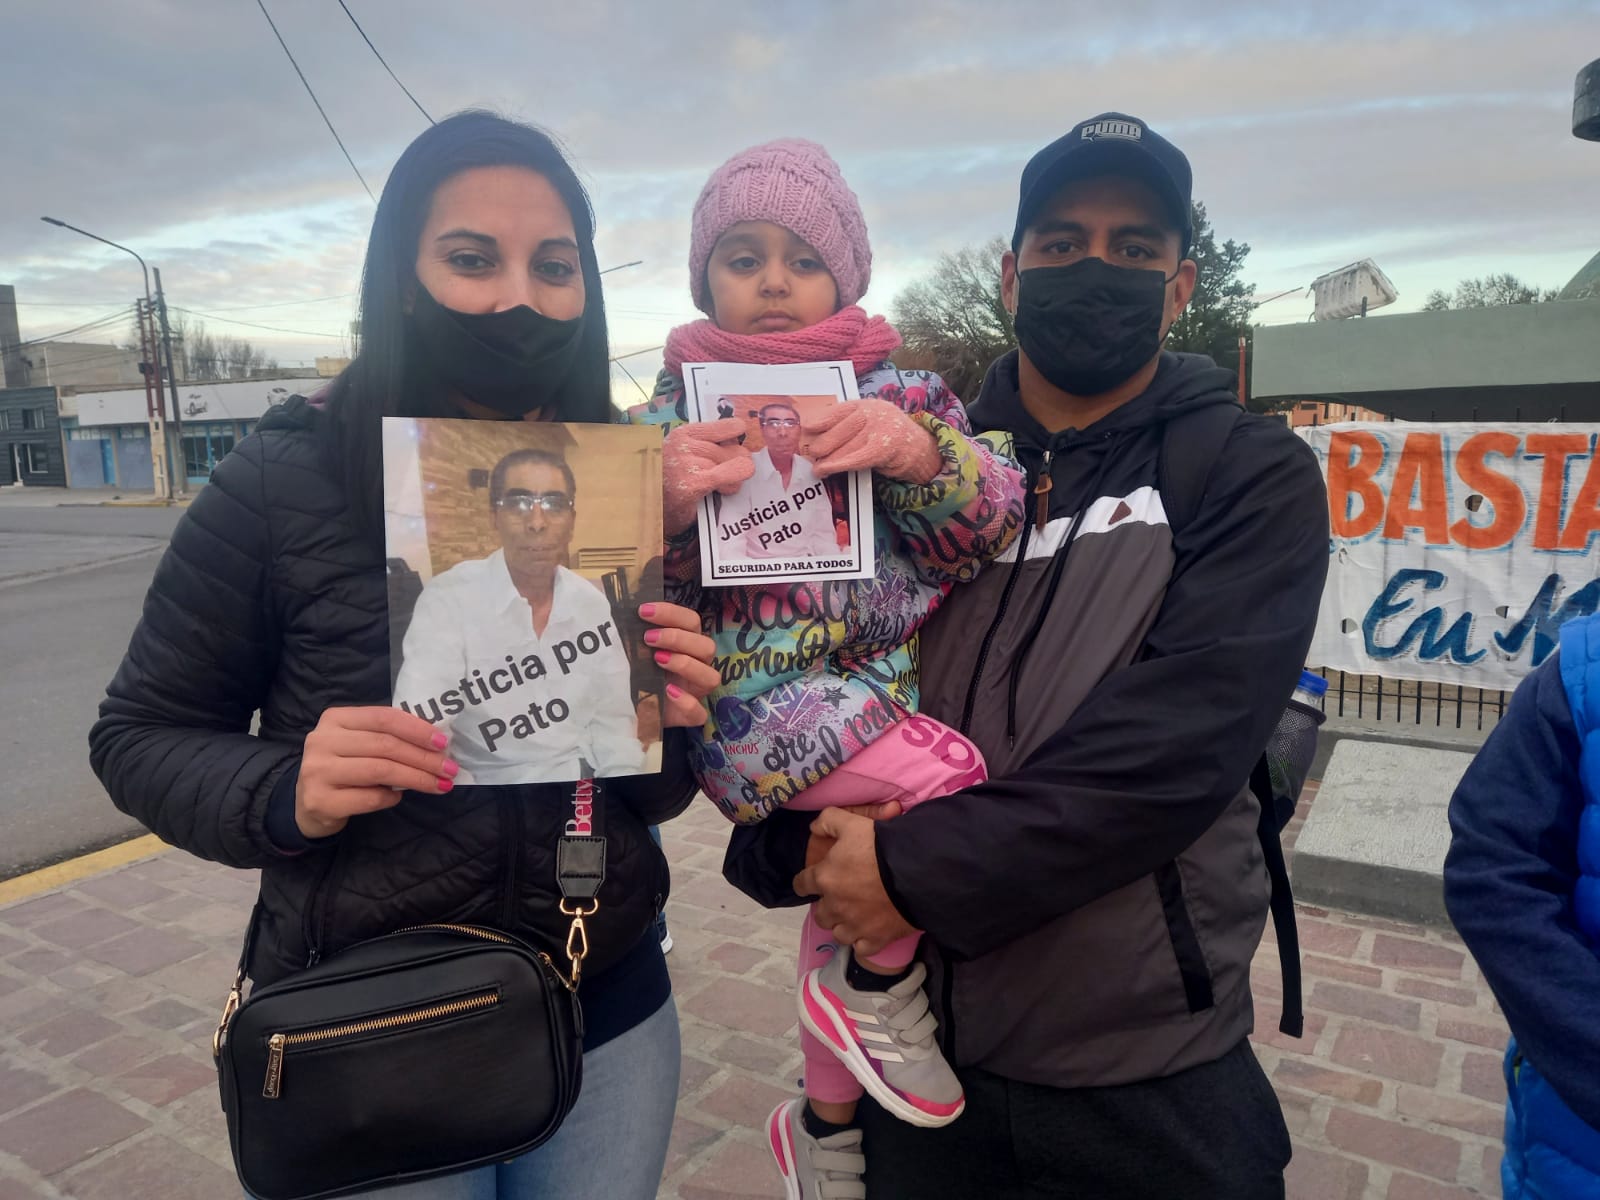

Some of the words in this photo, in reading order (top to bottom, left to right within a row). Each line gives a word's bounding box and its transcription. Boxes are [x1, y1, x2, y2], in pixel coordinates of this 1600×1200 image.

[1081, 122, 1142, 141] PUMA
[719, 499, 791, 541] Justicia
[792, 481, 823, 511] por
[1326, 431, 1600, 551] BASTA
[757, 521, 803, 550] Pato
[718, 562, 782, 574] SEGURIDAD
[783, 561, 814, 572] PARA
[815, 559, 853, 570] TODOS
[400, 655, 547, 725] usticia
[551, 620, 613, 674] por
[478, 697, 570, 752] Pato
[564, 779, 602, 836] Betty
